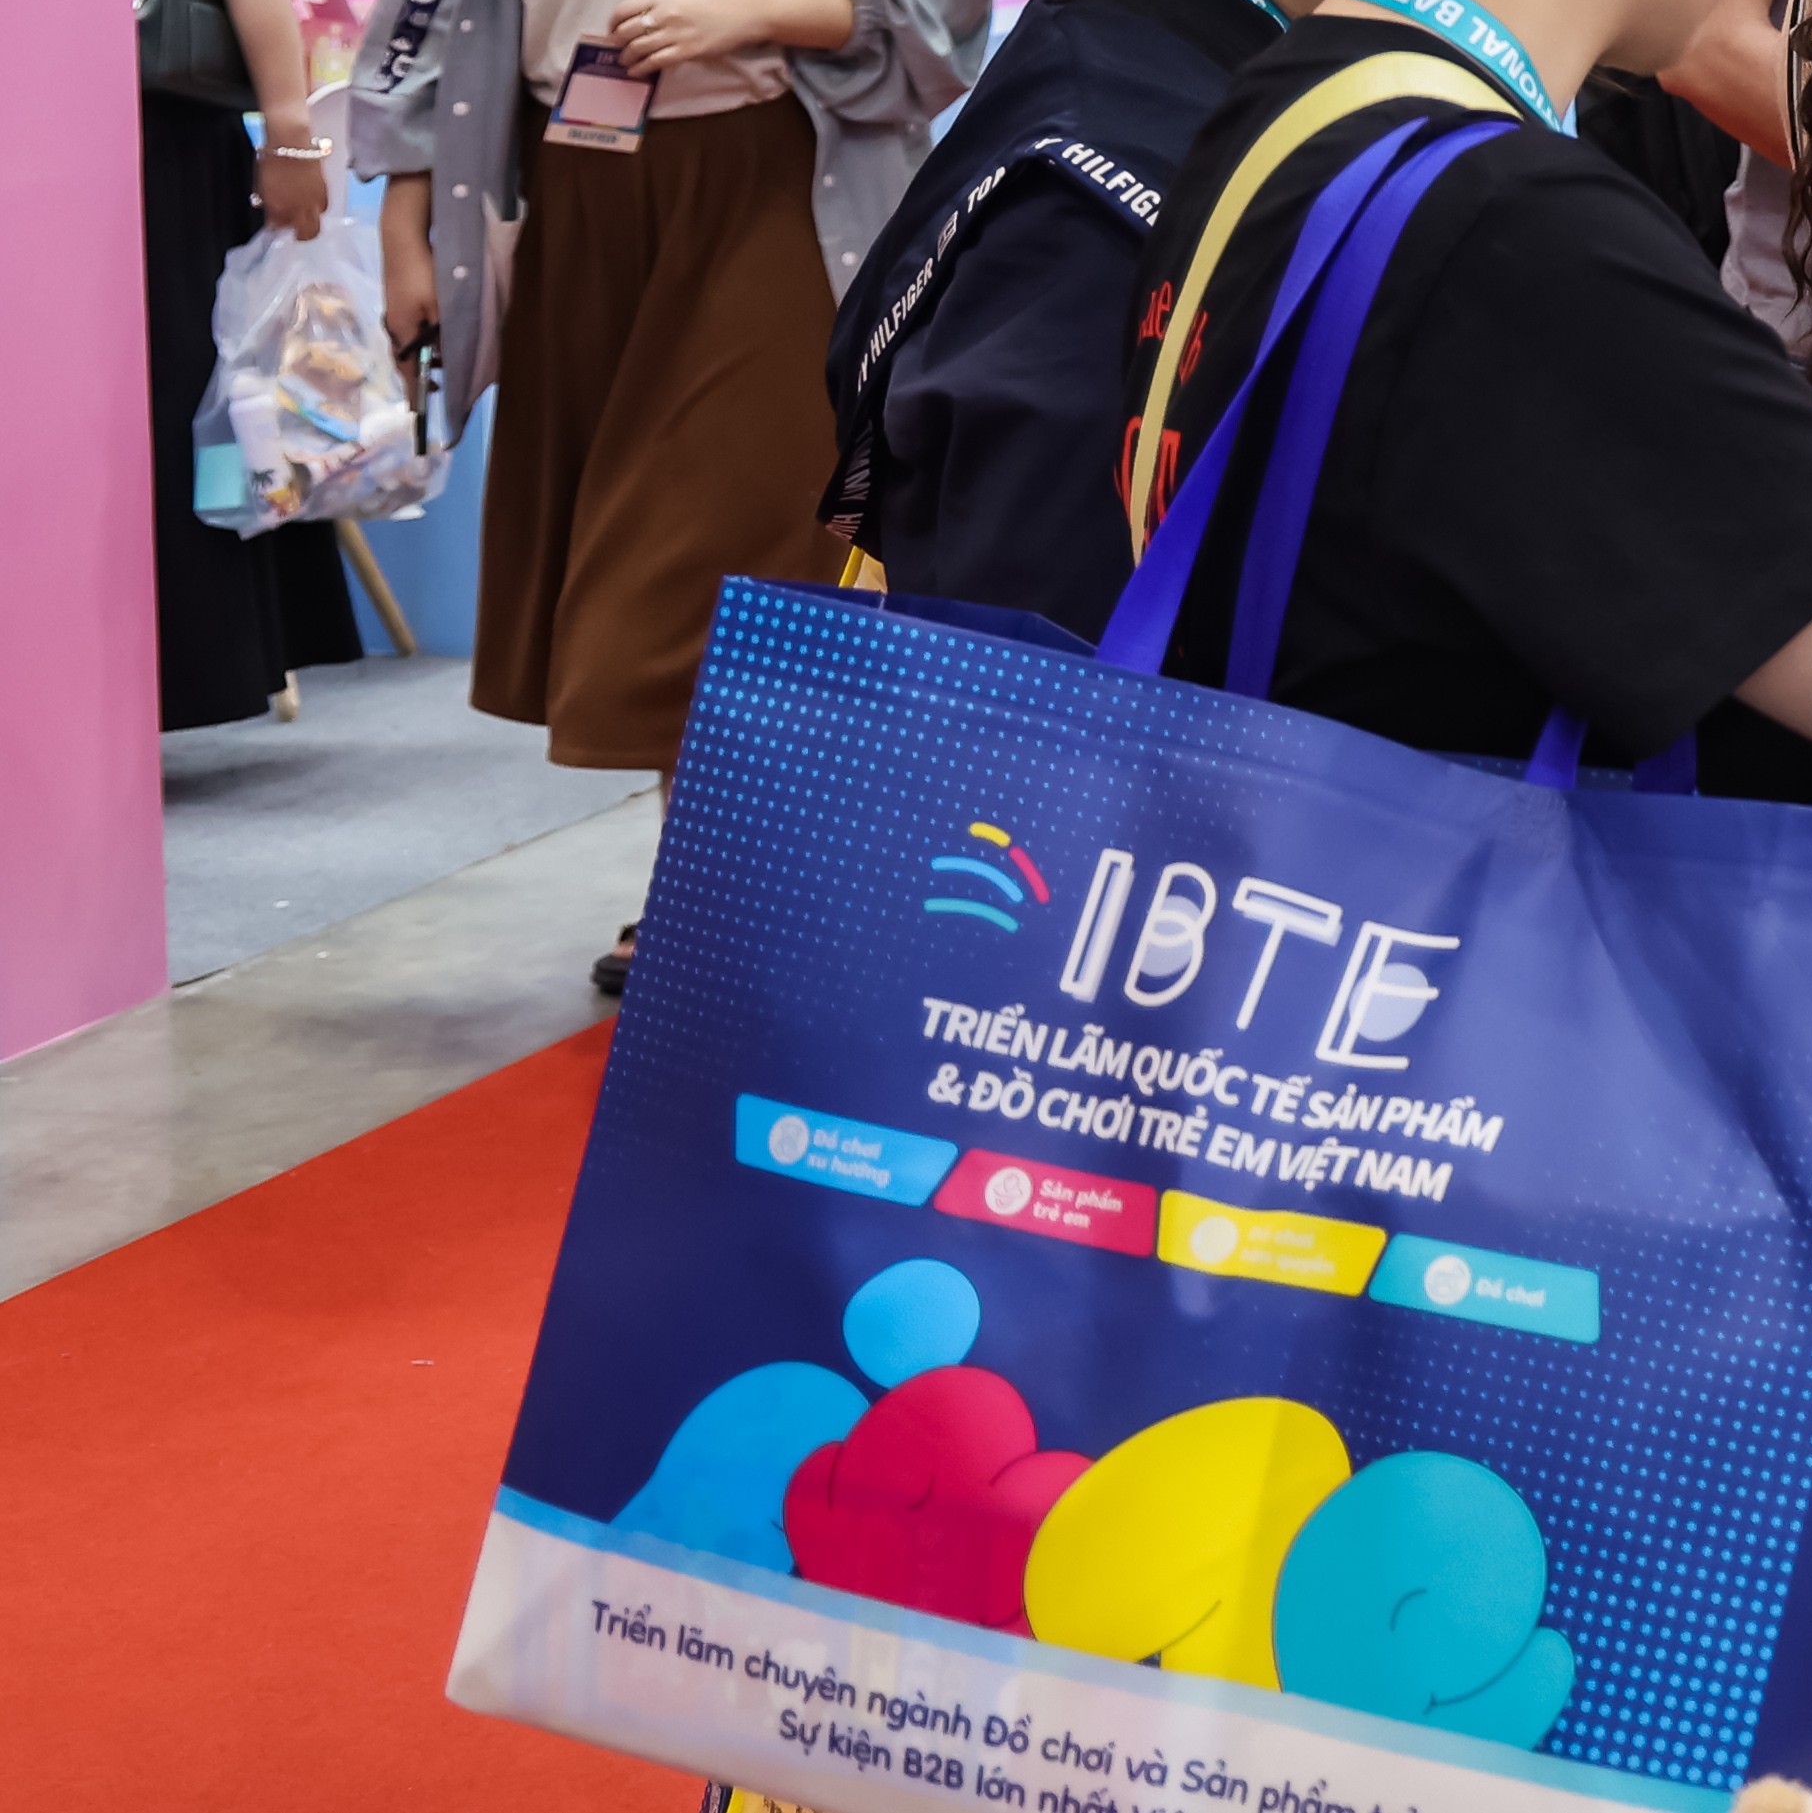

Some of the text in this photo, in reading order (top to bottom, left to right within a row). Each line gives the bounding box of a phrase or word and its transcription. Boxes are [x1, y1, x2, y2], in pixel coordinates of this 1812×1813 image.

[869, 256, 935, 364] HILFIGER
[1059, 848, 1460, 1071] IBTE
[922, 997, 1049, 1065] TRIỂN
[1047, 1024, 1133, 1083] LÃM
[1131, 1047, 1246, 1109] QUỐC
[1250, 1073, 1312, 1125] TẾ
[1302, 1084, 1384, 1134] SẢN
[926, 1064, 1454, 1202] & ĐỒ CHƠI TRẺ EM VIỆT NAM
[1063, 1209, 1092, 1229] em
[590, 1599, 666, 1653] Triển
[676, 1620, 735, 1672] lãm
[743, 1653, 858, 1708] chuyên
[867, 1689, 973, 1741] ngành
[982, 1713, 1033, 1754] Đồ
[1040, 1731, 1116, 1776] chơi
[1126, 1748, 1169, 1787] và
[1181, 1758, 1250, 1805] Sản
[779, 1710, 822, 1757] Sự
[828, 1722, 892, 1770] kiện
[902, 1749, 965, 1790] B2B
[975, 1764, 1026, 1808] lớn
